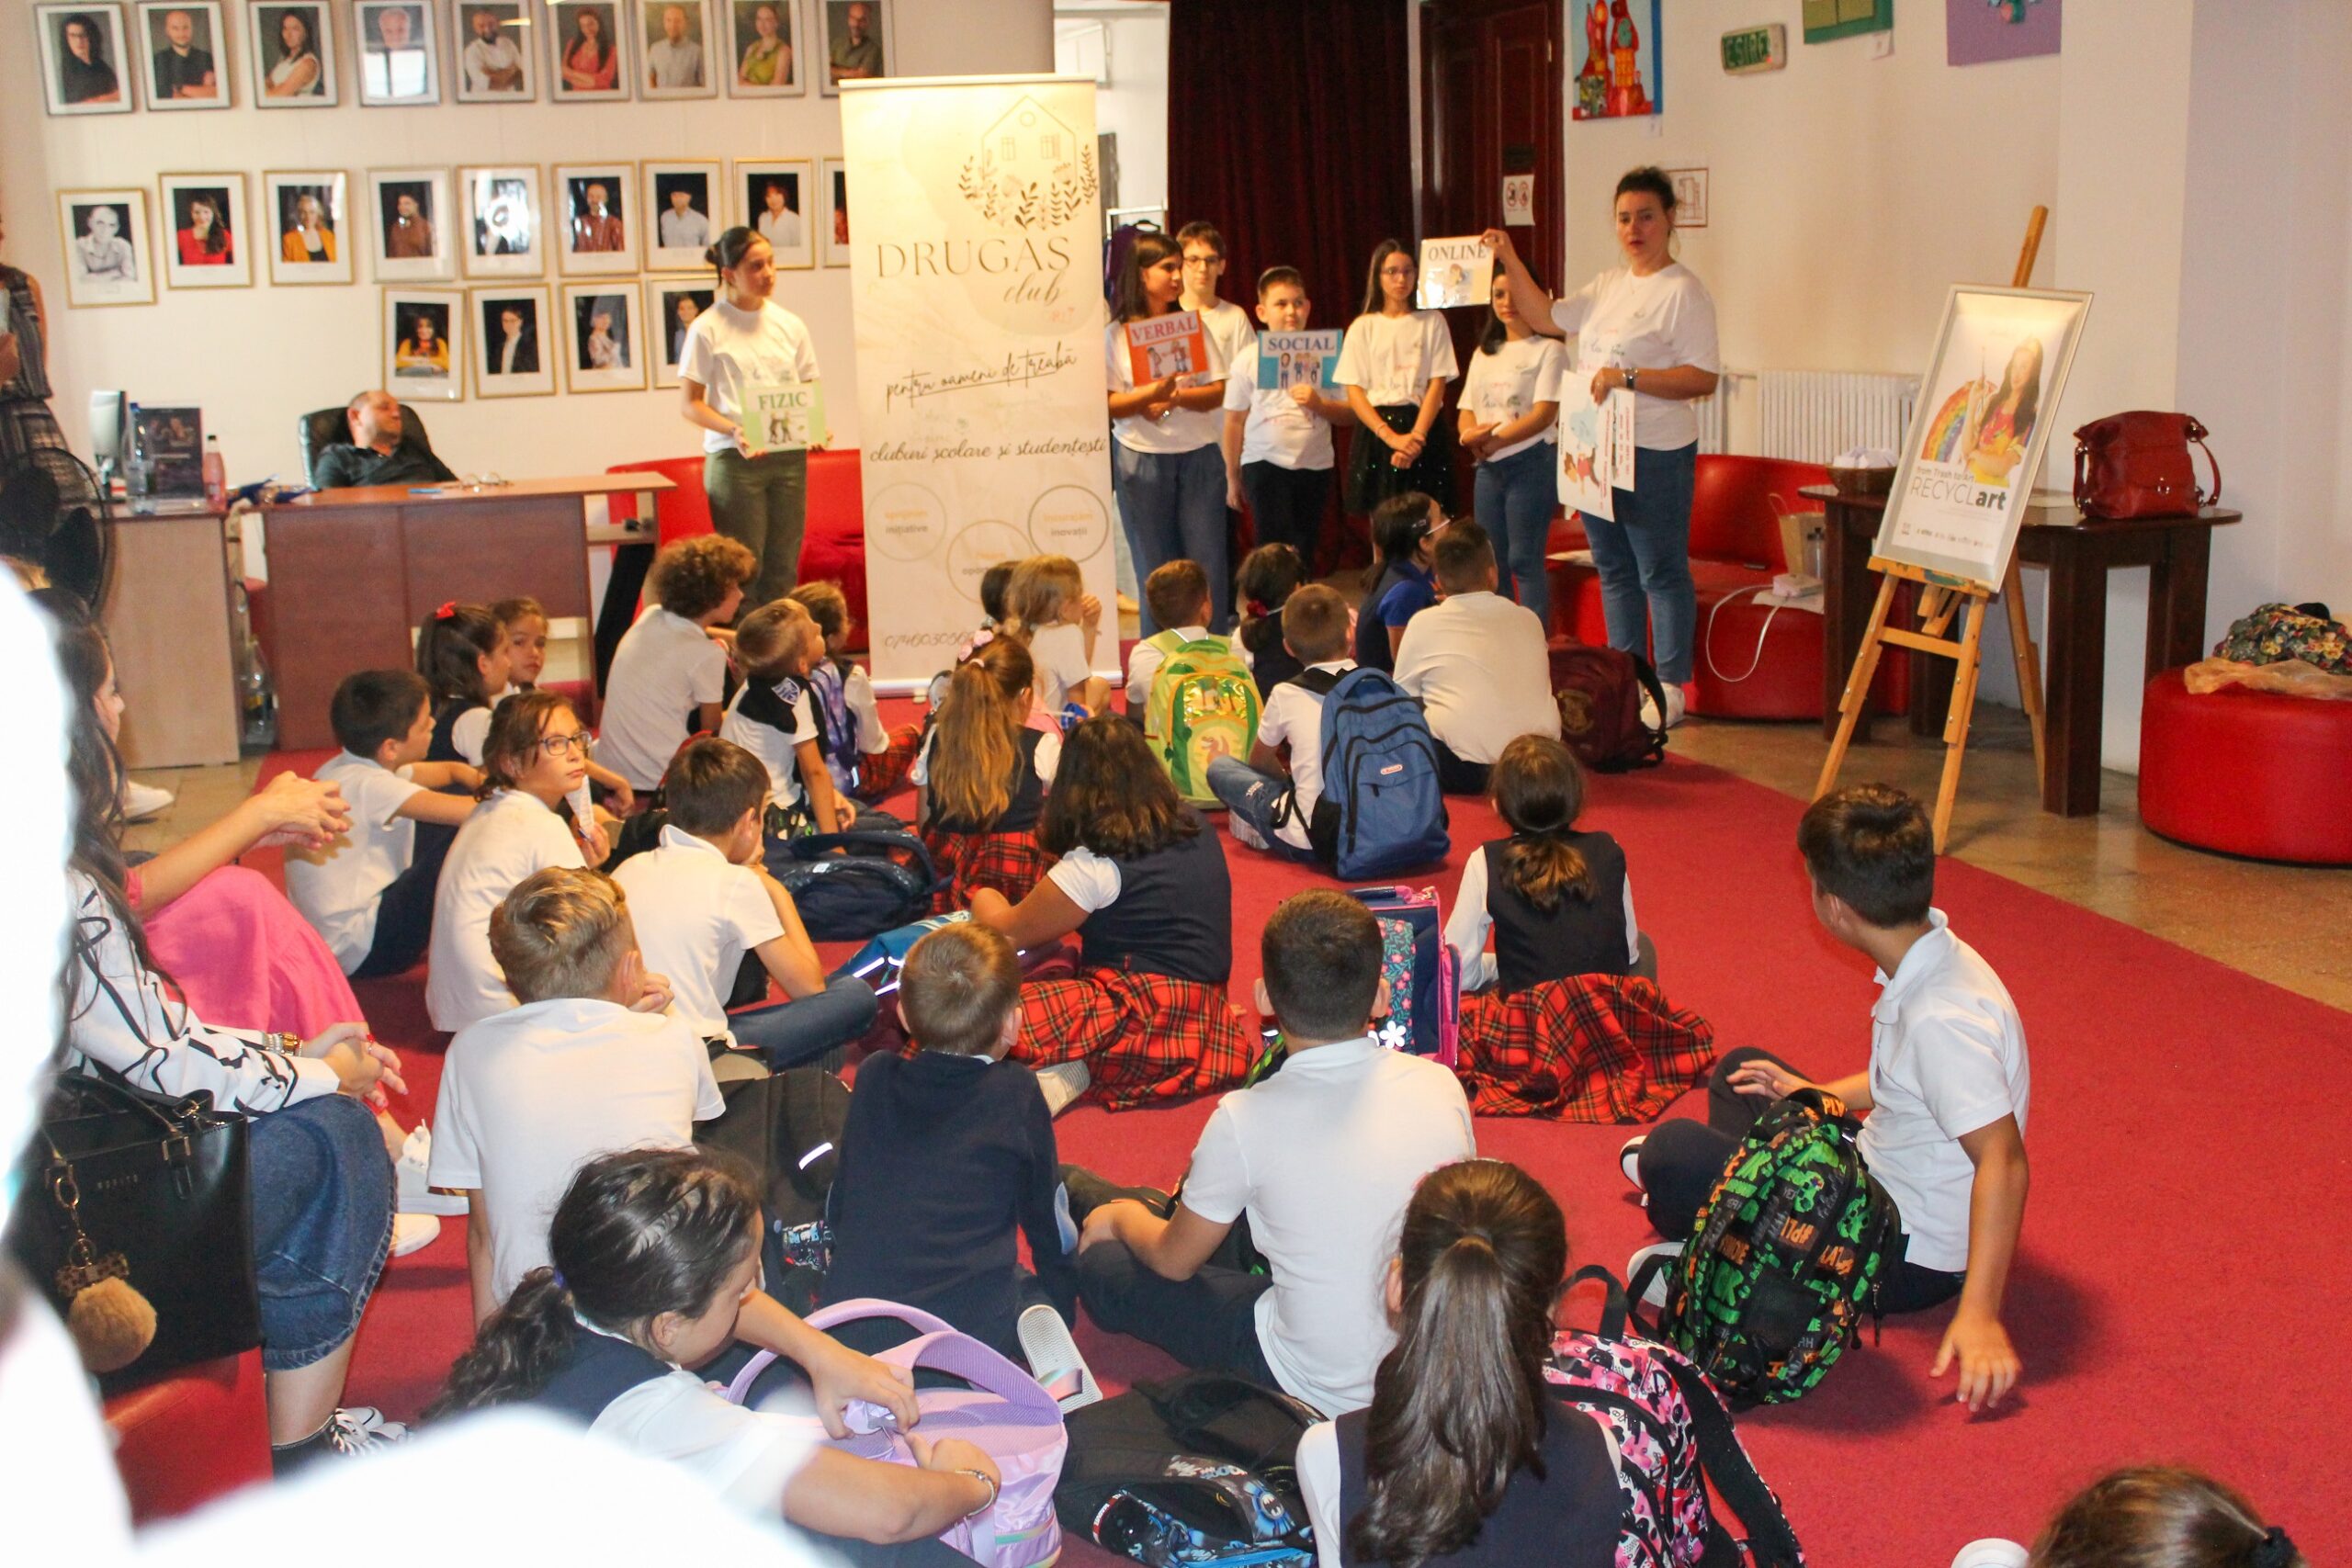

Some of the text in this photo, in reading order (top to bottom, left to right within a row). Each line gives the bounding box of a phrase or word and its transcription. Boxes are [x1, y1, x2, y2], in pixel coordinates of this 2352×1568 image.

[877, 235, 1071, 277] DRUGAS
[1428, 243, 1487, 261] ONLINE
[1002, 271, 1063, 306] club
[1132, 316, 1198, 342] VERBAL
[1268, 337, 1335, 351] SOCIAL
[887, 368, 934, 413] pentru
[940, 368, 998, 386] oameni
[1001, 353, 1021, 387] de
[758, 391, 808, 410] FIZIC
[870, 442, 928, 462] cluburi
[1910, 476, 2007, 511] RECYCLart
